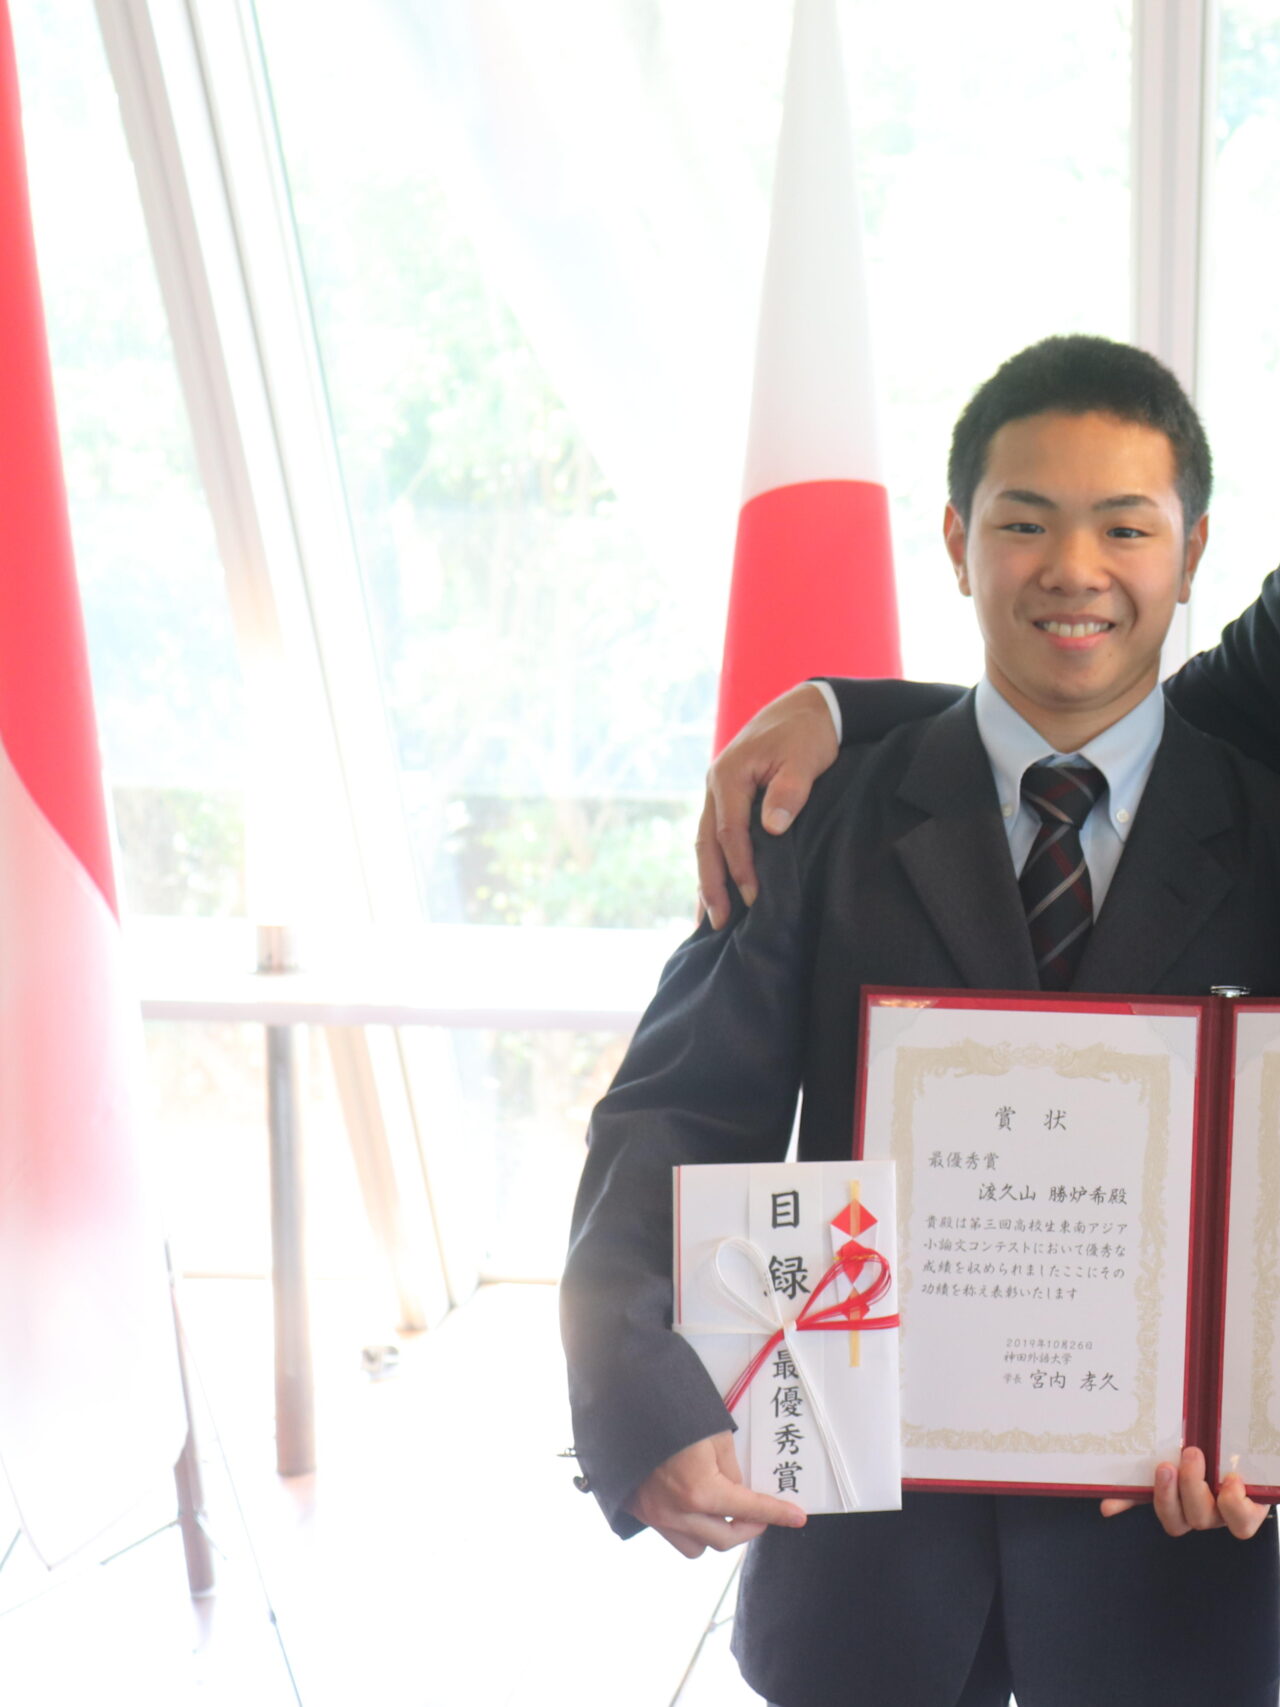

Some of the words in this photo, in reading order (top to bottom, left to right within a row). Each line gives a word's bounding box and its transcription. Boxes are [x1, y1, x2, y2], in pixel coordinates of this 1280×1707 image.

[928, 1152, 999, 1170] 最優秀賞
[978, 1182, 1036, 1202] 渡久山
[764, 1190, 811, 1300] 目録
[1006, 1338, 1093, 1350] 2019年10月26日
[1004, 1351, 1072, 1365] 神田外語大学
[1030, 1369, 1066, 1389] 宮内
[1080, 1371, 1119, 1392] 孝久
[770, 1350, 804, 1494] 最優秀賞
